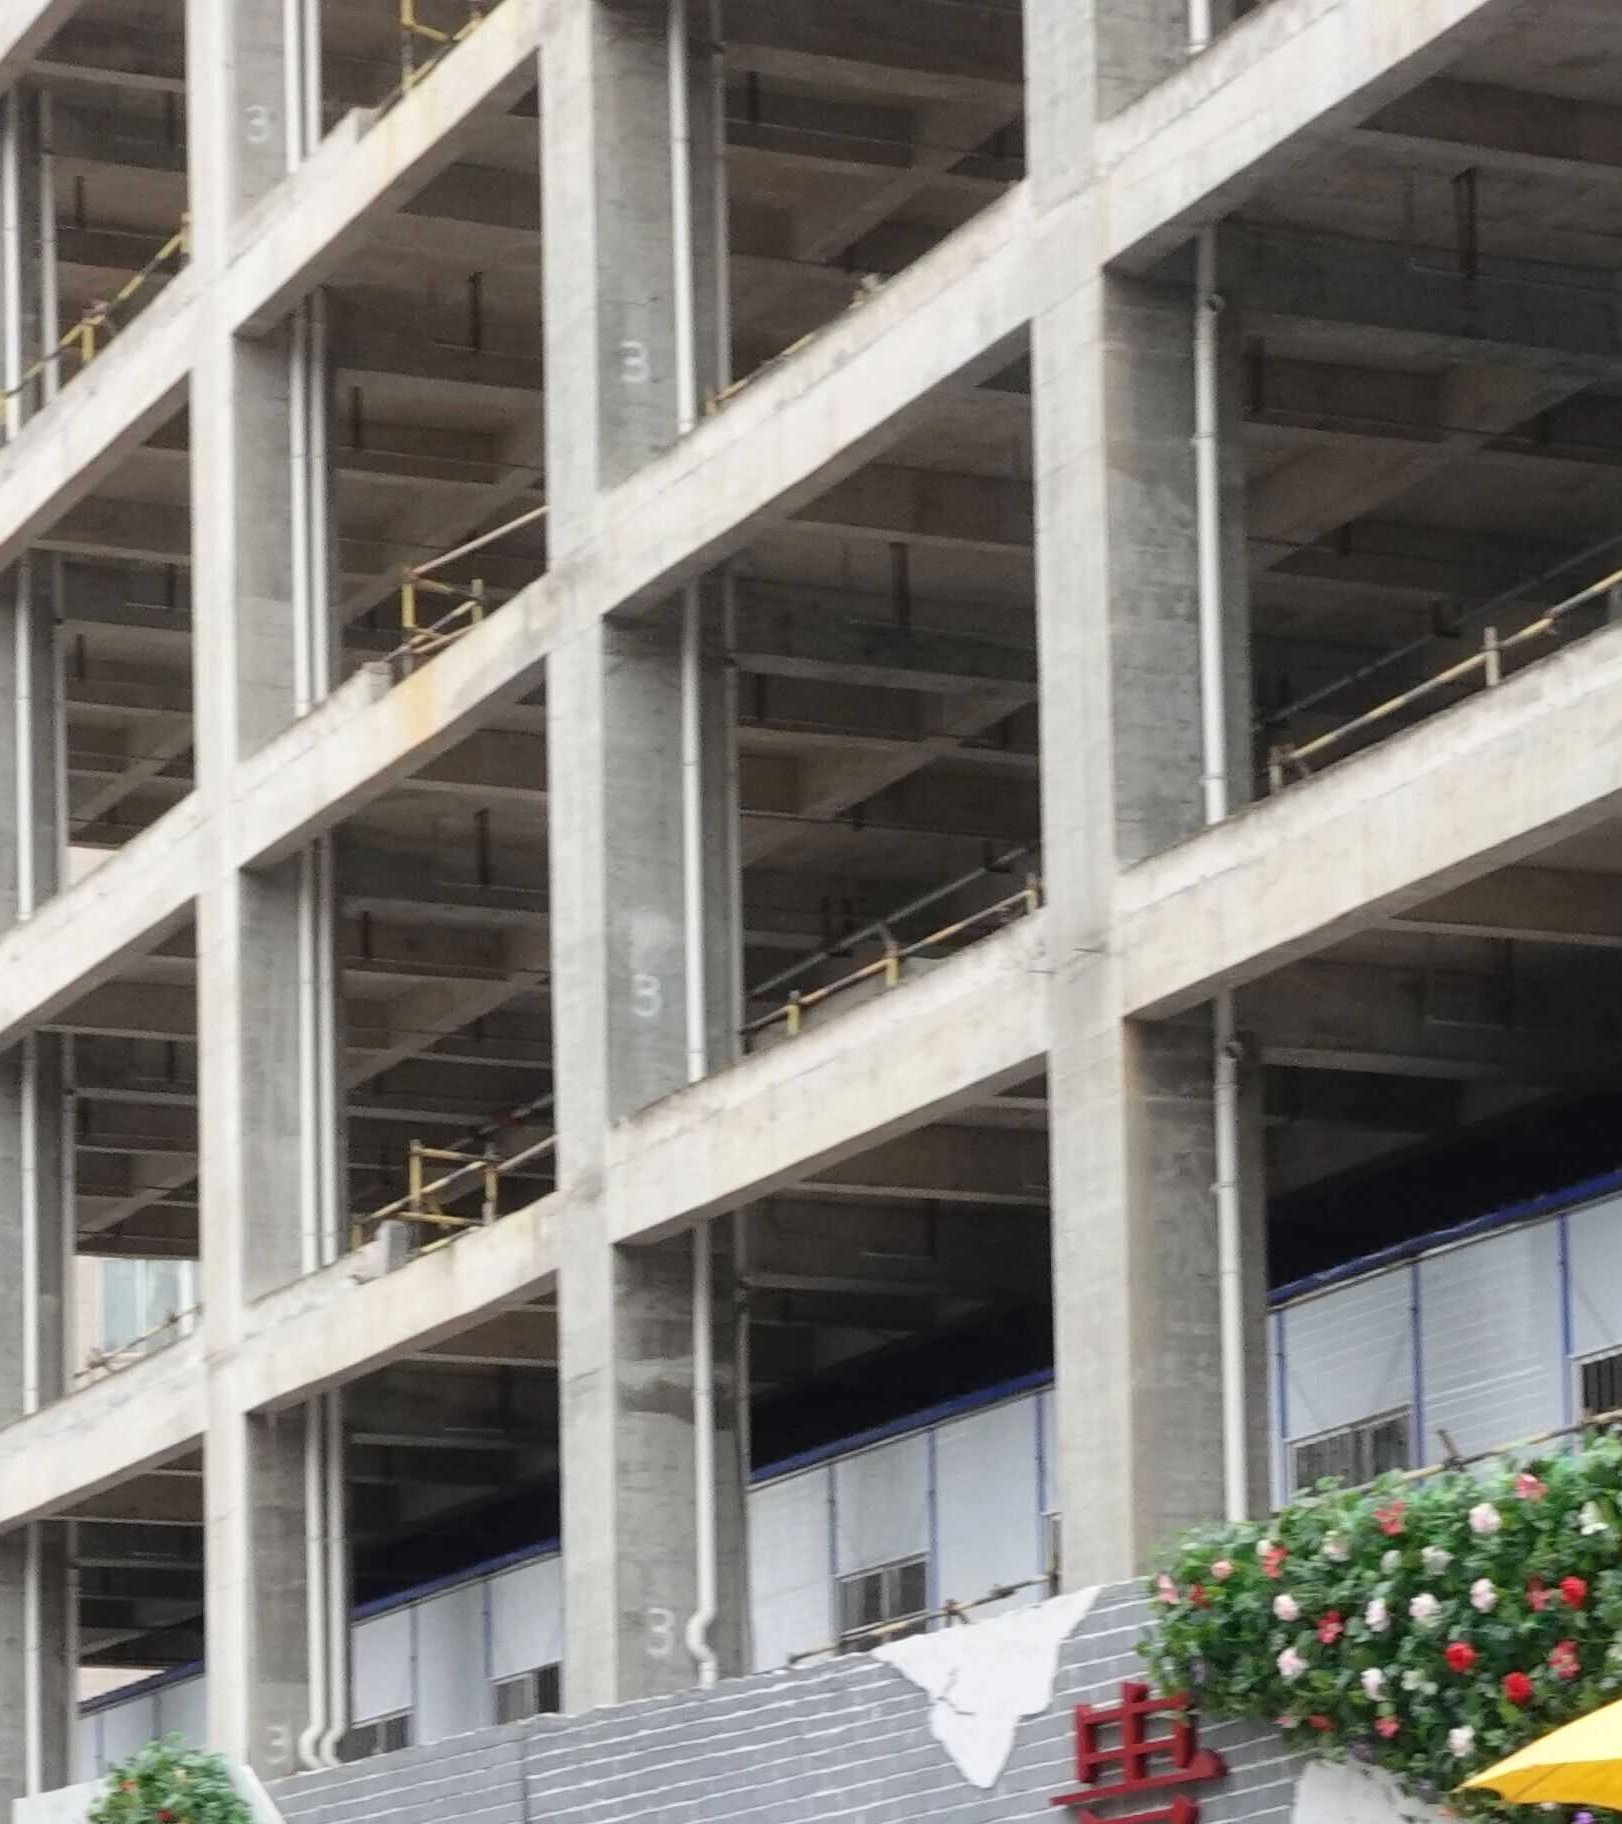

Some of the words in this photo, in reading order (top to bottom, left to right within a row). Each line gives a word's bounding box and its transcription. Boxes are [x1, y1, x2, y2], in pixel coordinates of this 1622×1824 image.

[243, 104, 268, 144] 3
[620, 341, 649, 384] 3
[633, 974, 663, 1017] 3
[645, 1607, 675, 1656] 3
[266, 1725, 291, 1765] 3
